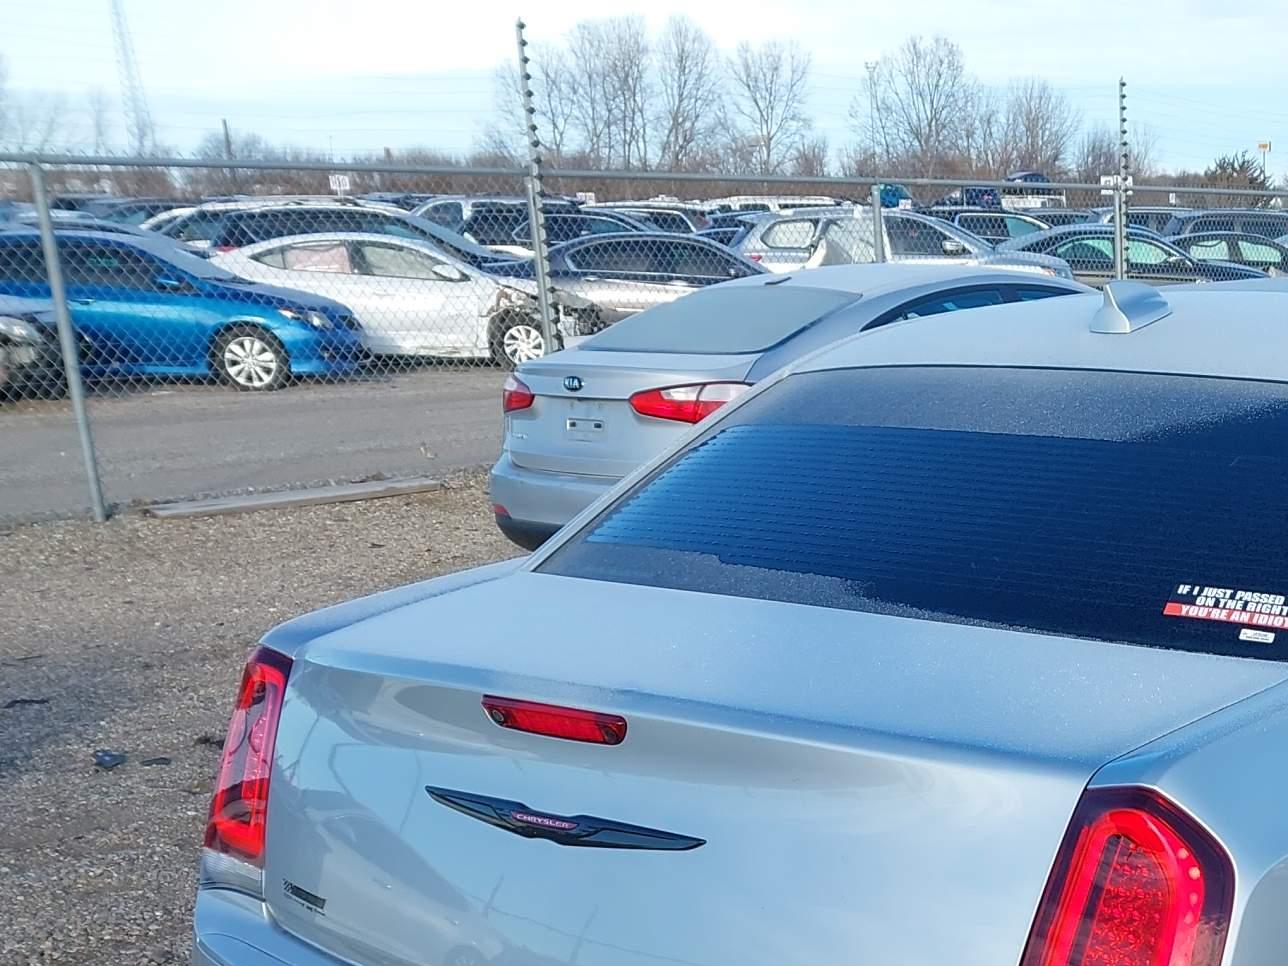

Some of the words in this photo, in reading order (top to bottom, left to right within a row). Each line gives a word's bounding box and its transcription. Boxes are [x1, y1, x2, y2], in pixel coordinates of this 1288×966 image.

[563, 377, 580, 389] KIA
[1177, 584, 1192, 595] IF
[1192, 586, 1200, 596] I
[1200, 587, 1234, 600] JUST
[1234, 590, 1286, 605] PASSED
[1195, 596, 1217, 608] ON
[1217, 598, 1243, 612] THE
[1179, 604, 1228, 619] YOU'RE
[1229, 611, 1250, 622] AN
[516, 813, 570, 829] CHRYSLER
